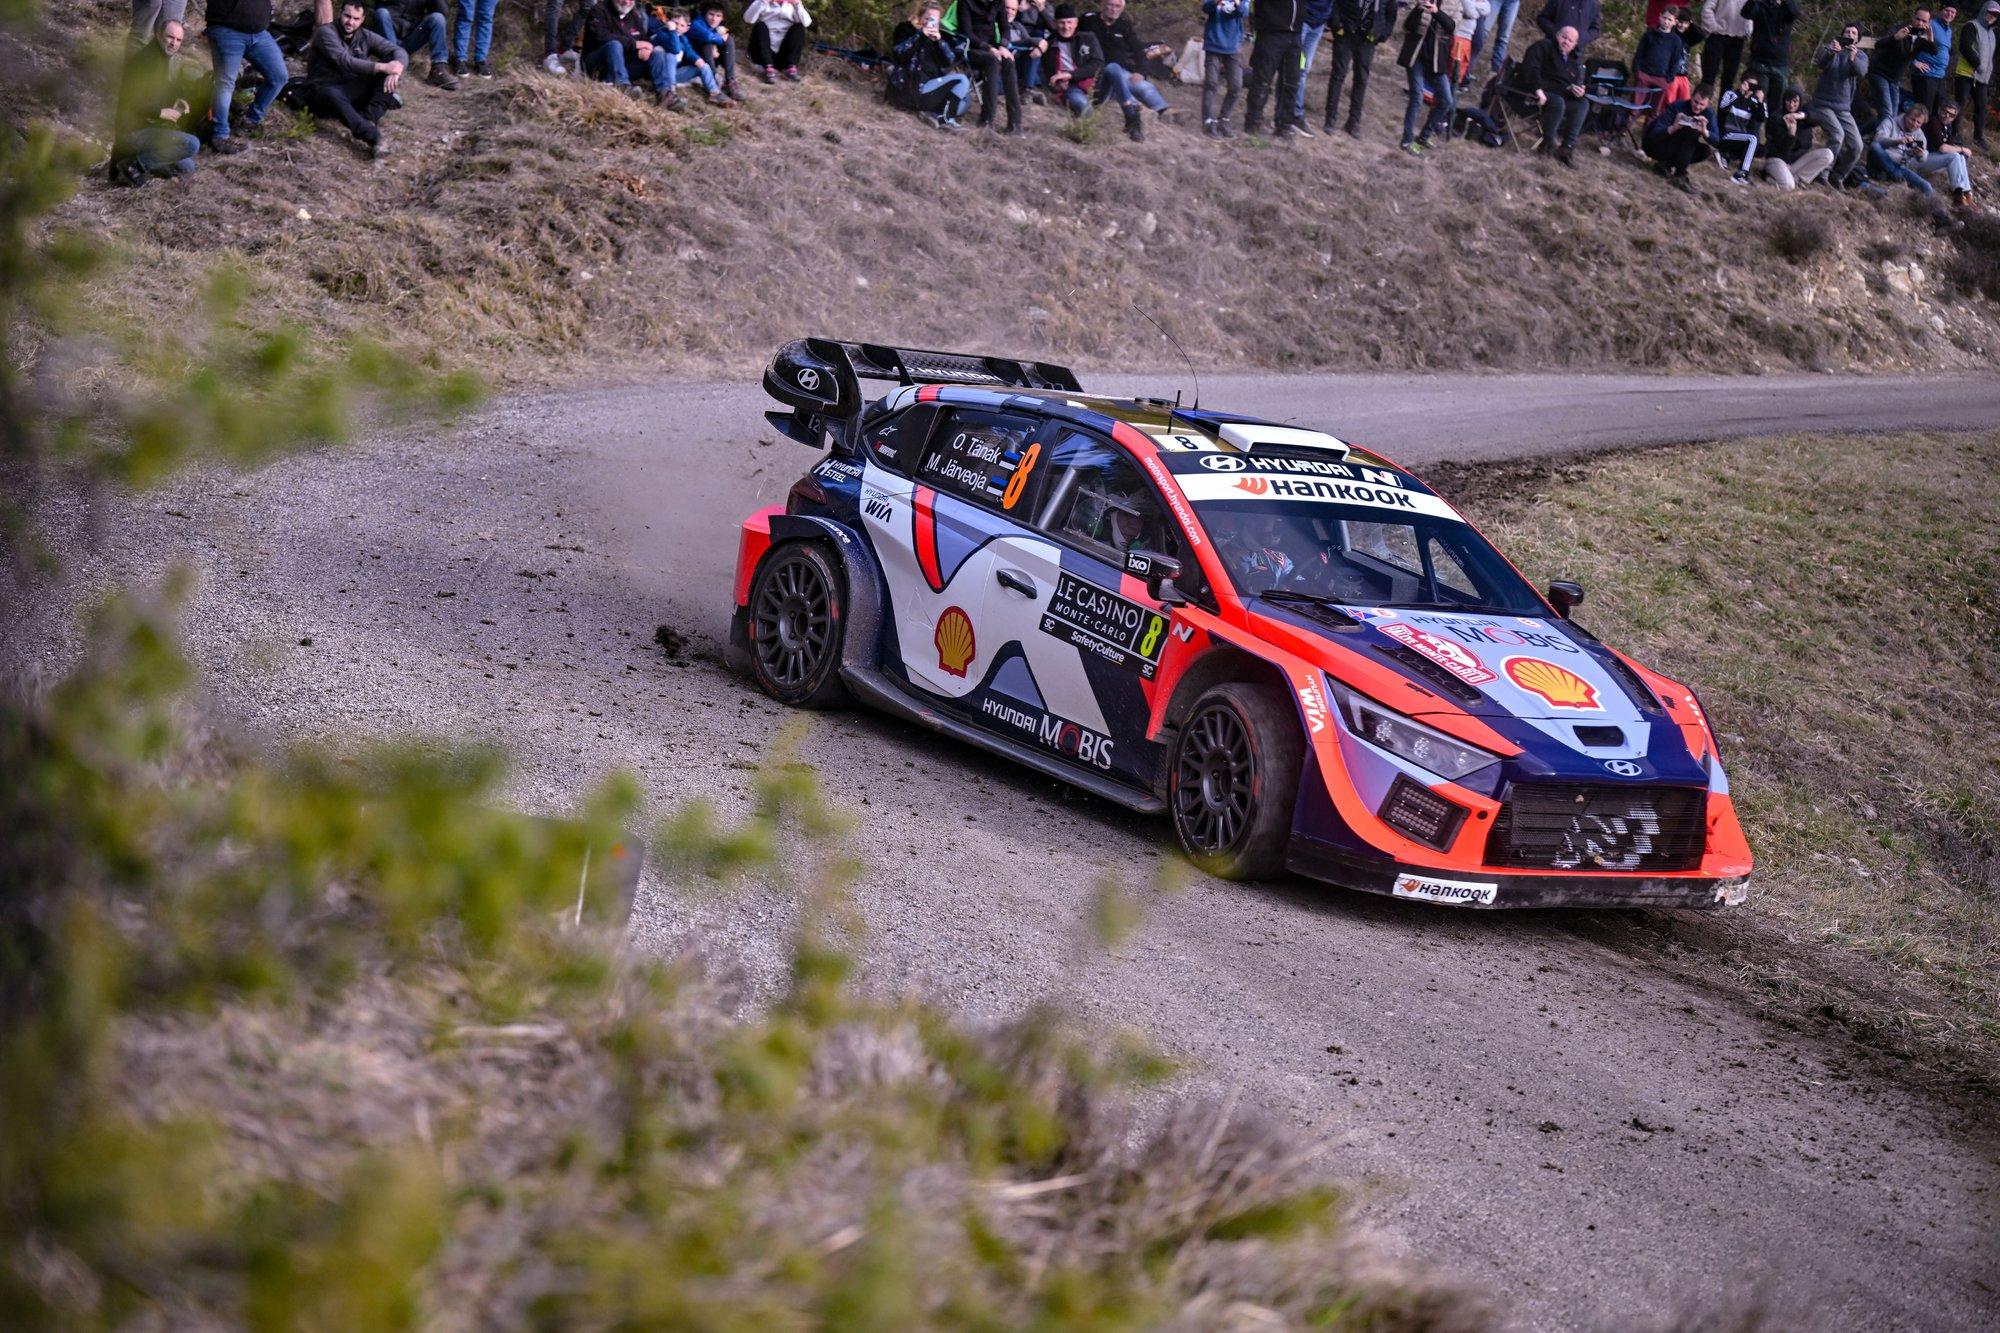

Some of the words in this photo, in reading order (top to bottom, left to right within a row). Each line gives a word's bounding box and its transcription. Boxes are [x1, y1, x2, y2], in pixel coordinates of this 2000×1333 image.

[953, 433, 967, 451] O.
[967, 437, 1001, 464] Tänak
[1174, 435, 1198, 450] 8
[825, 467, 847, 483] STEEL
[833, 461, 862, 478] HYUNDAI
[926, 452, 939, 471] M.
[940, 459, 987, 491] Järveoja
[1003, 443, 1041, 510] 8
[1249, 457, 1355, 477] HYUNDAI
[865, 499, 893, 523] WIA
[1144, 456, 1201, 546] motorsport.hyundai.com
[1057, 577, 1076, 601] LE
[1076, 587, 1138, 629] CASINO
[1055, 603, 1091, 624] MONTE
[1094, 622, 1126, 642] CARLO
[1140, 615, 1163, 657] 8
[1410, 616, 1502, 628] HYUNDAI
[1070, 630, 1125, 663] SafetyCulture
[1445, 625, 1580, 655] MOBIS
[983, 698, 1037, 733] HYUNDAI
[1039, 715, 1115, 771] MOBIS
